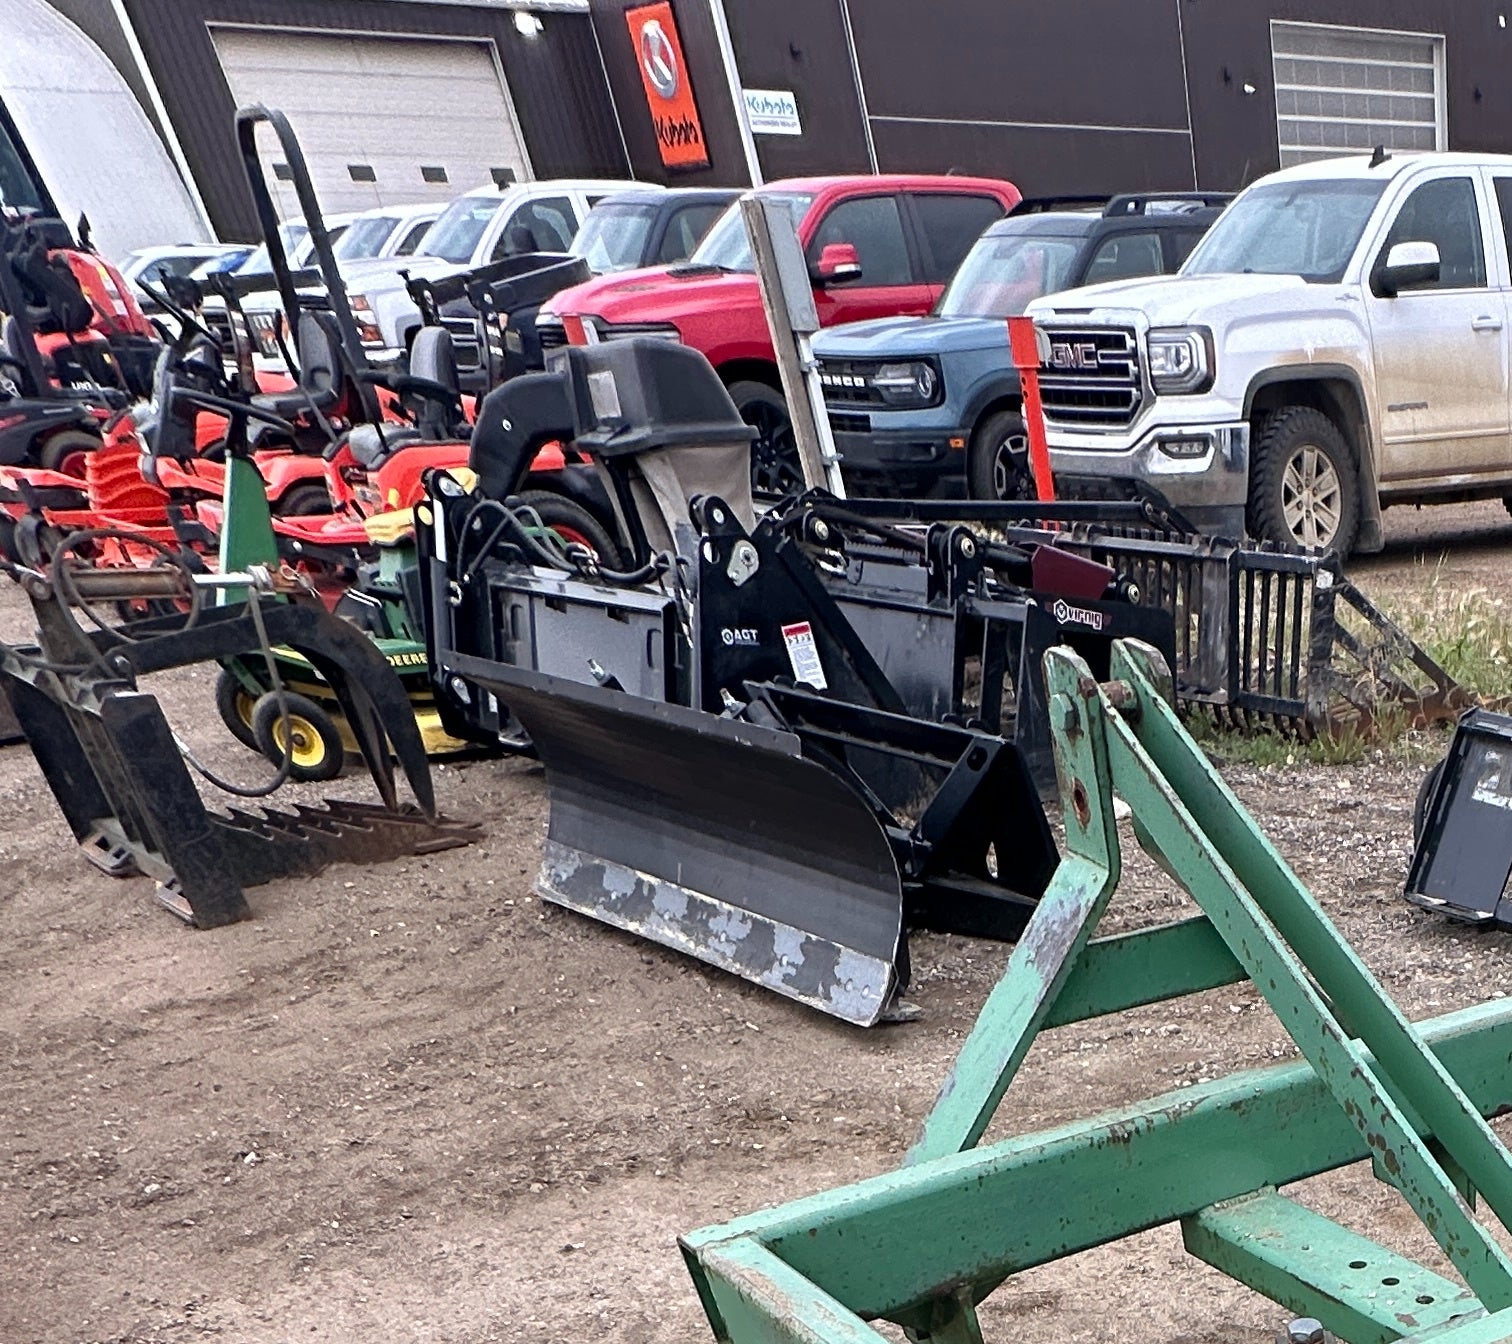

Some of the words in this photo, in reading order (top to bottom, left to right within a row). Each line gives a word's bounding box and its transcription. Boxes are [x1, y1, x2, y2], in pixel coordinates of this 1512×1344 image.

[746, 95, 794, 115] Kubota
[656, 113, 698, 148] Kubota
[1052, 343, 1098, 369] GMC
[1068, 605, 1103, 631] virnig
